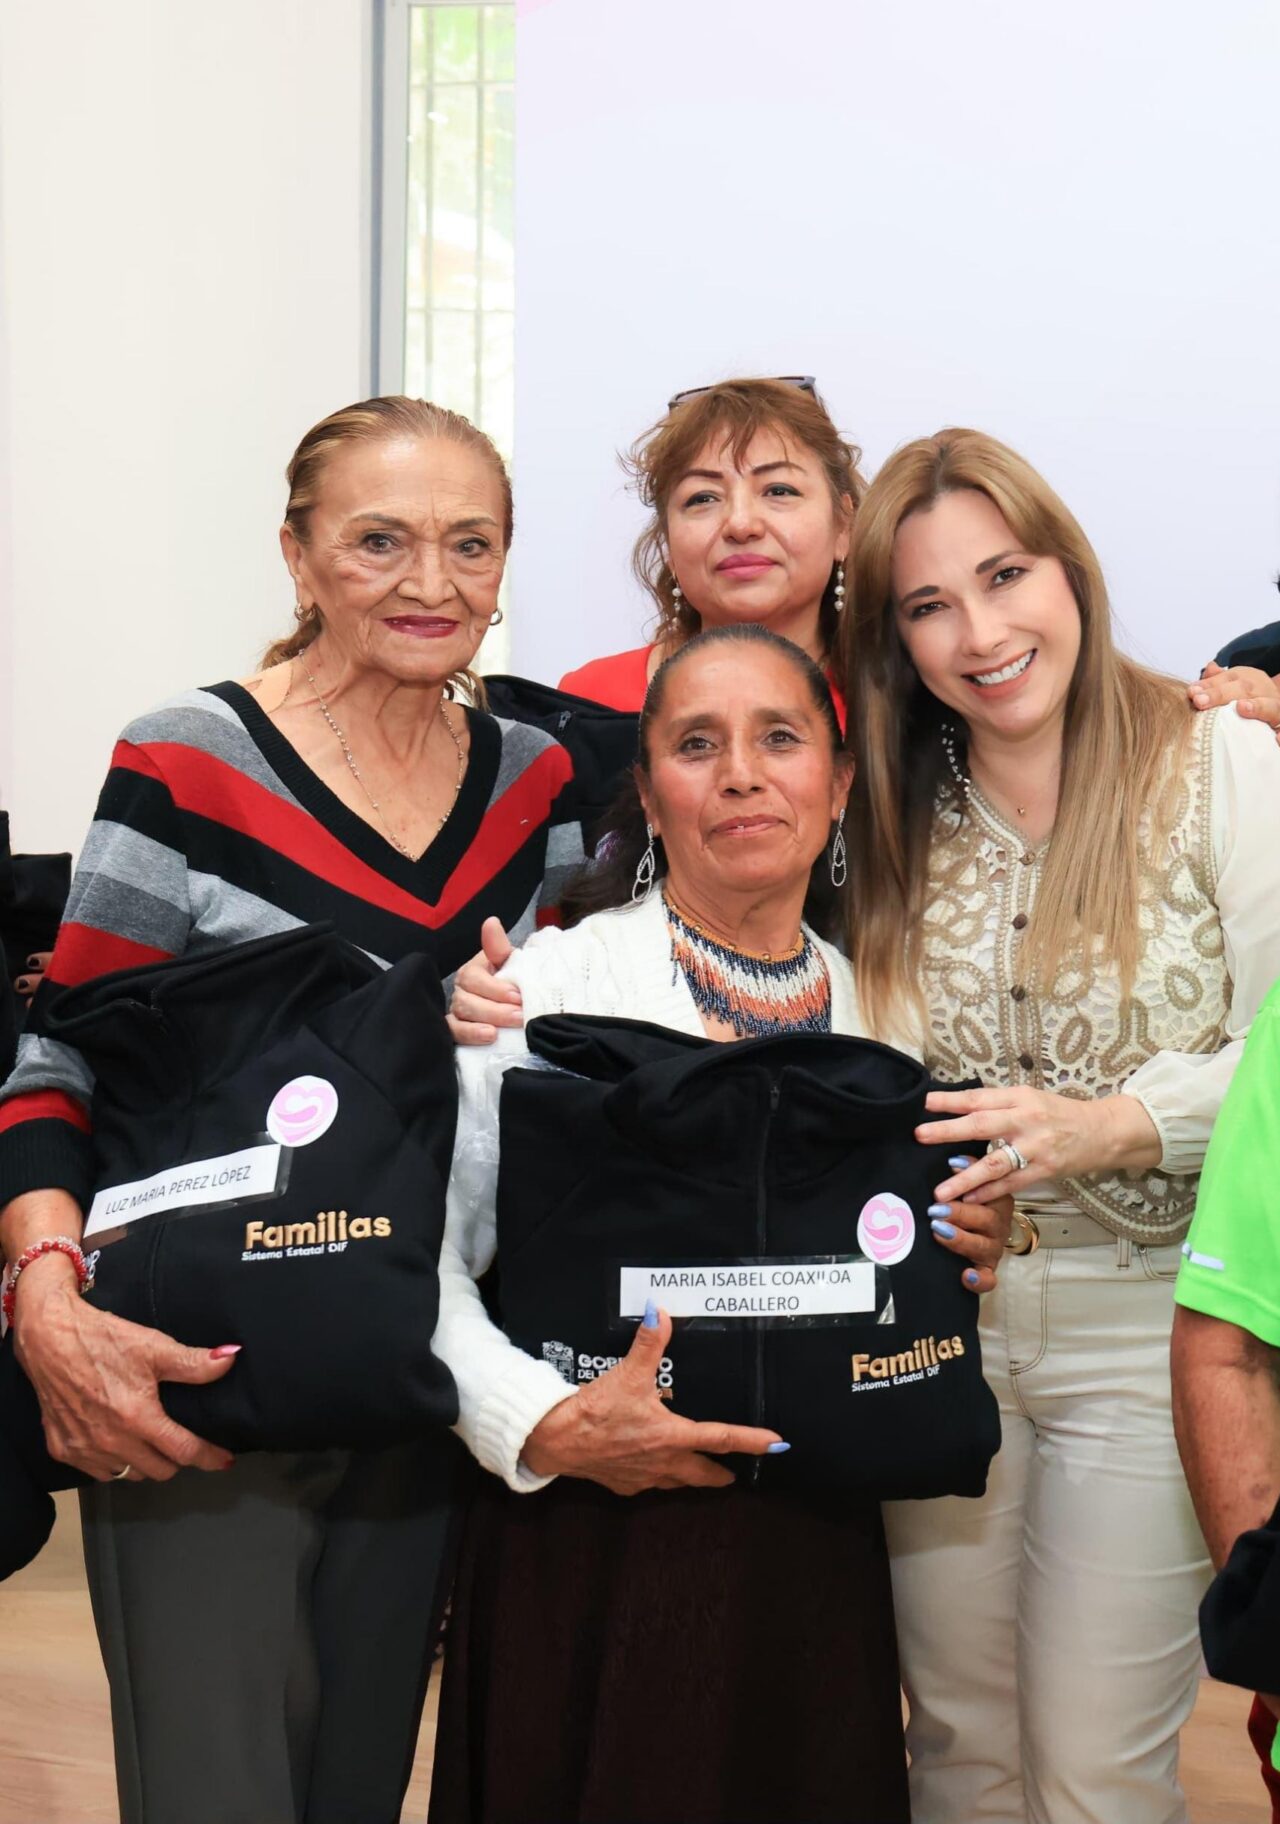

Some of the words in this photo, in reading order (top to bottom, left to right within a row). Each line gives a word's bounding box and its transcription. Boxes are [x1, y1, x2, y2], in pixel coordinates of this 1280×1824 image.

[105, 1200, 130, 1215] LUZ
[129, 1185, 166, 1208] MARIA
[169, 1175, 209, 1195] PEREZ
[211, 1165, 252, 1187] LÓPEZ
[245, 1210, 392, 1250] Familias
[241, 1250, 283, 1261] Sistema
[286, 1244, 325, 1257] Estatal
[328, 1241, 349, 1253] DIF
[650, 1273, 706, 1288] MARIA
[712, 1271, 767, 1287] ISABEL
[704, 1296, 800, 1312] CABALLERO
[851, 1335, 965, 1382] Familias
[851, 1379, 890, 1392] Sistema
[893, 1371, 925, 1385] Estatal
